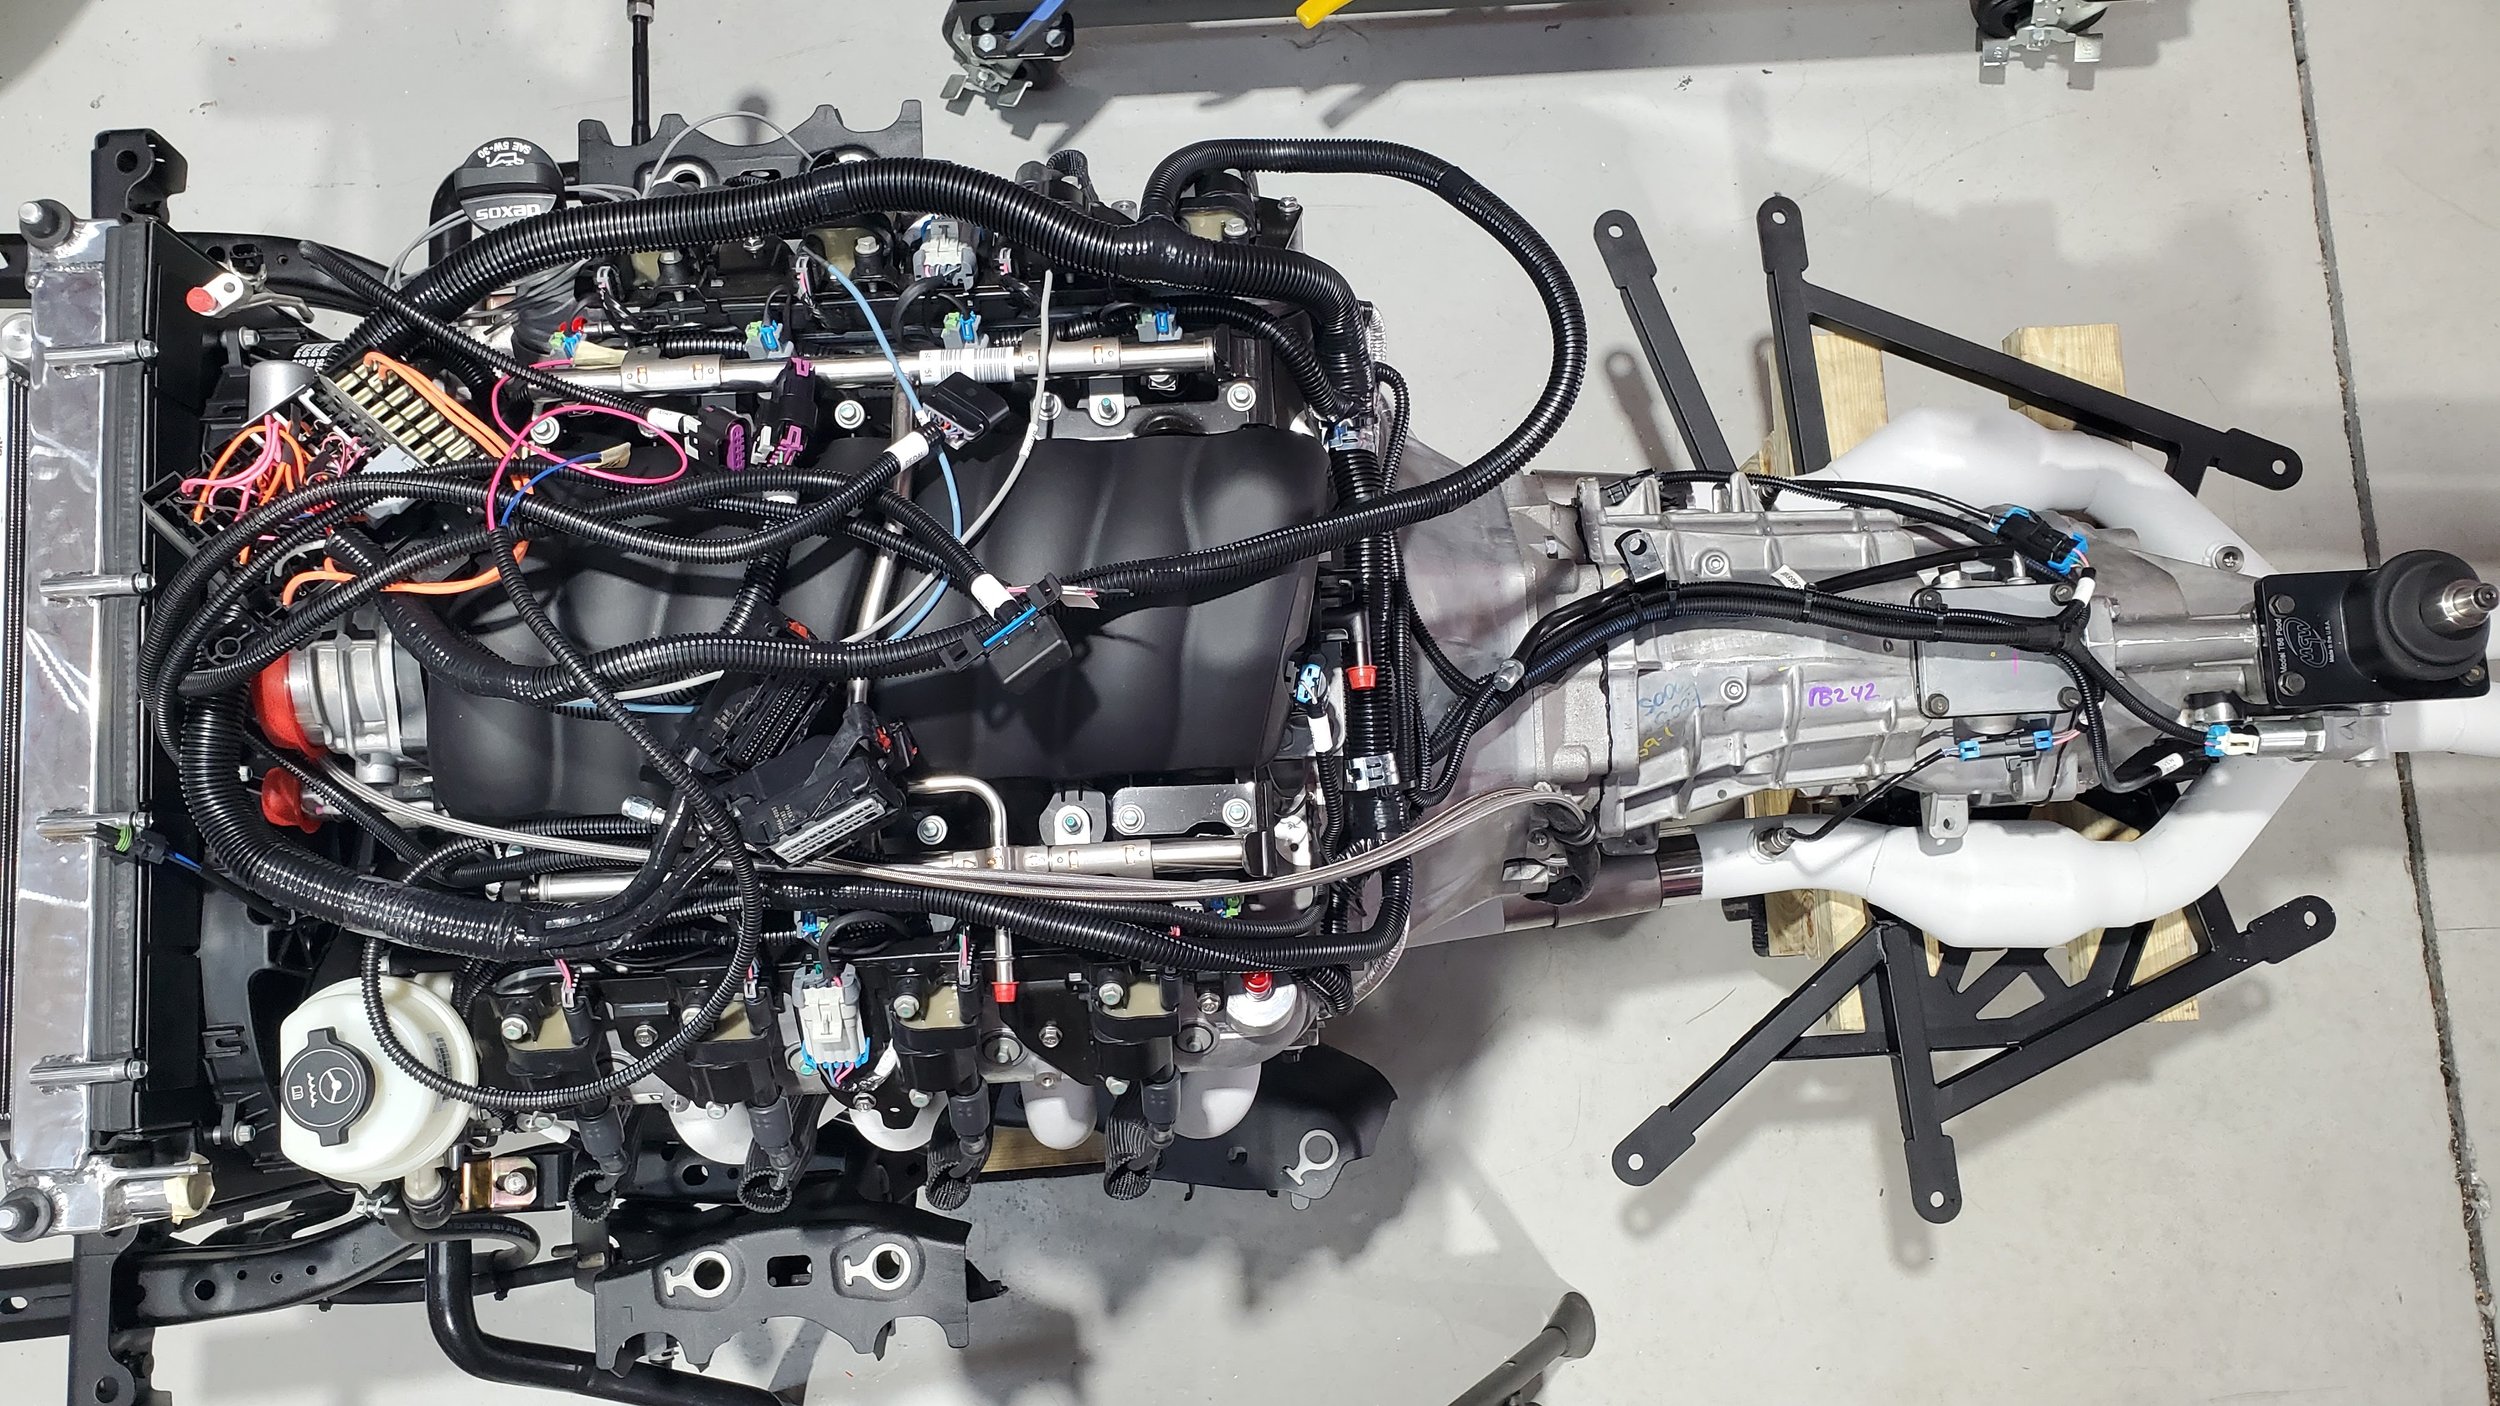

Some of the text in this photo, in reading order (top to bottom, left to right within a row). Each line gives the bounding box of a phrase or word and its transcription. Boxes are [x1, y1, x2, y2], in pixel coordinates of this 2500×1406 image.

[512, 141, 531, 154] SAE
[475, 203, 541, 221] dexos
[905, 451, 924, 467] PEDAL
